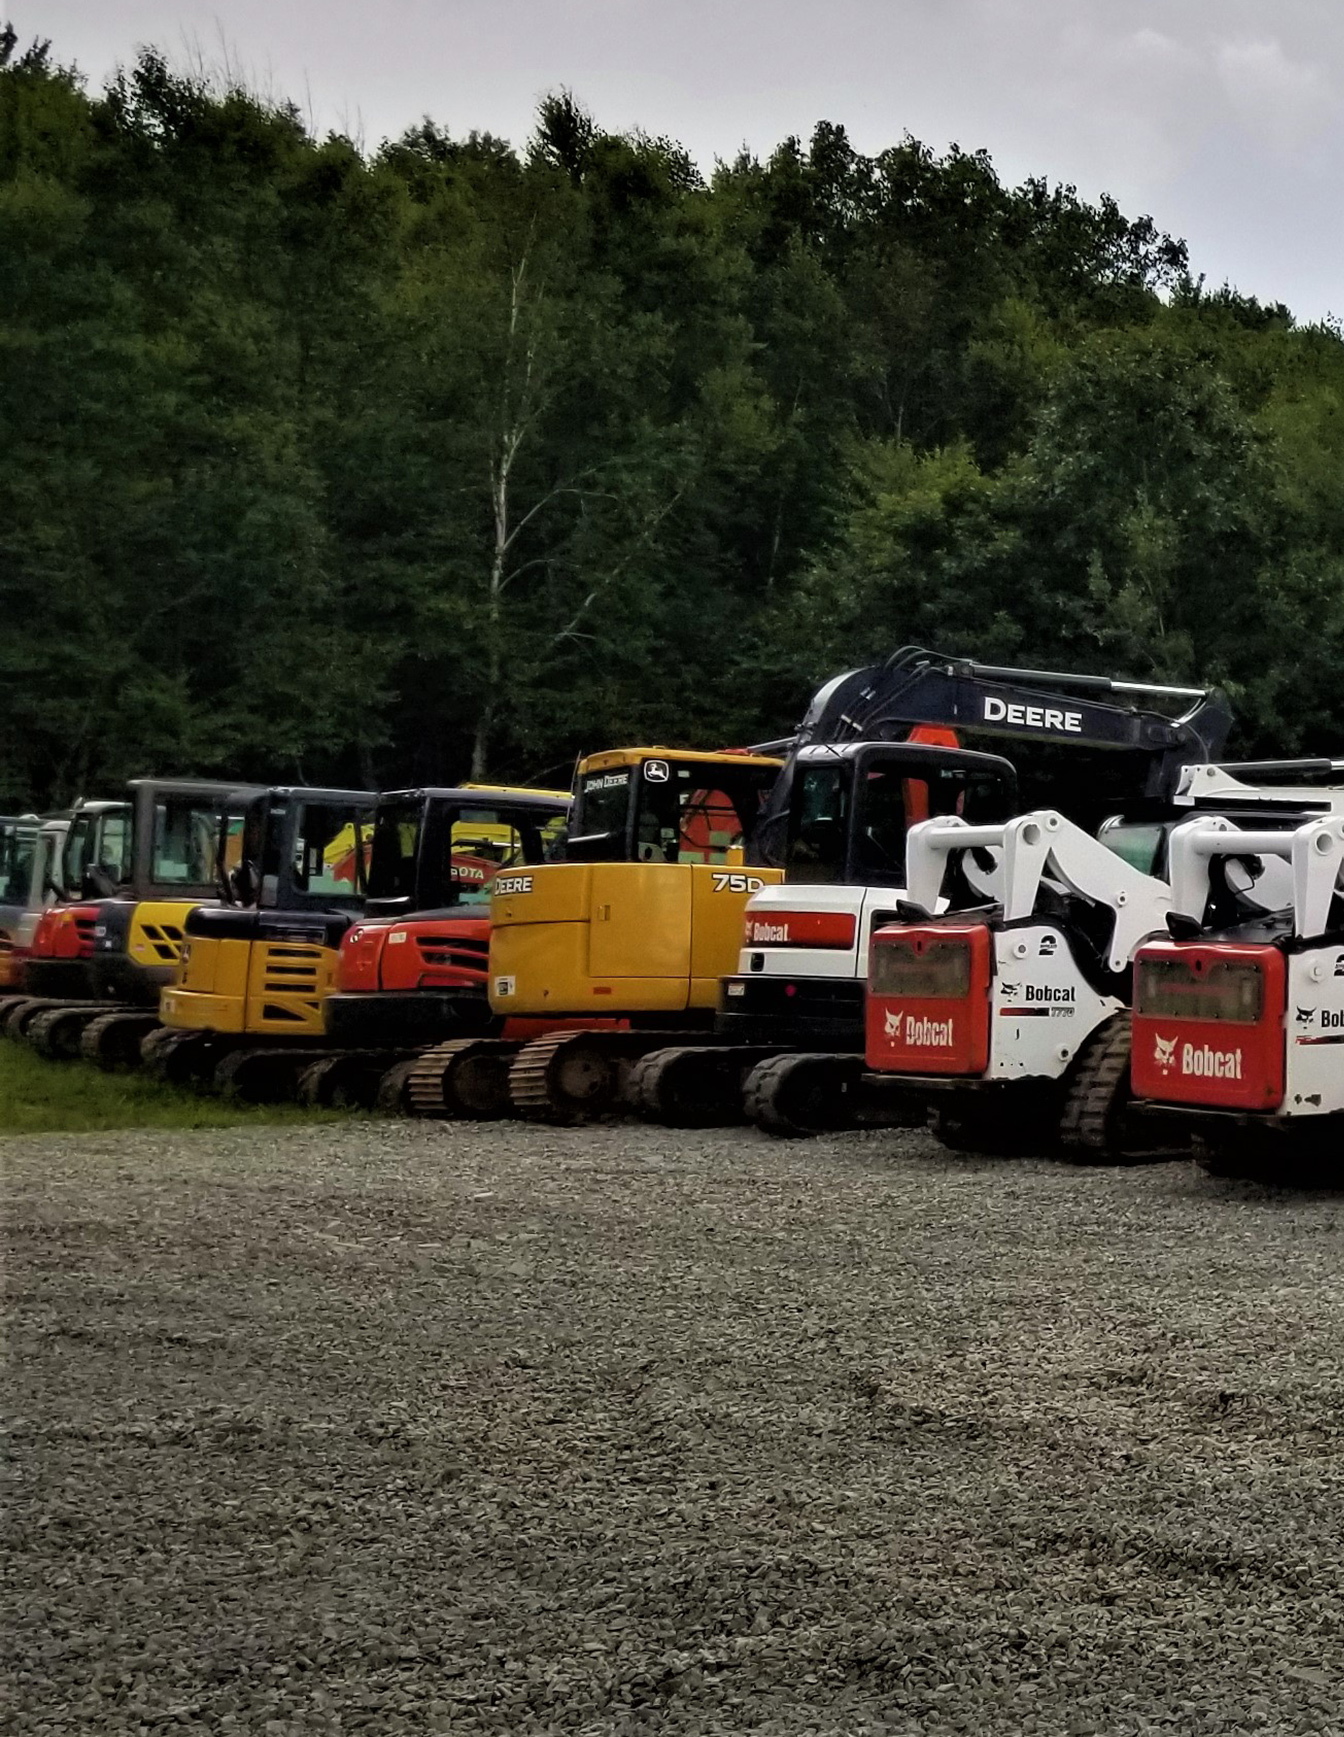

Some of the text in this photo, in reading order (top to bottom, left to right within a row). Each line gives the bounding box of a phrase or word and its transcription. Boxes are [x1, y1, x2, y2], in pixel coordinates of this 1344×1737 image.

[983, 696, 1082, 732] DEERE
[494, 876, 532, 896] DEERE
[712, 873, 764, 893] 75D
[753, 922, 788, 942] Bobcat
[1025, 985, 1076, 1002] Bobcat
[905, 1016, 953, 1047] Bobcat
[1182, 1042, 1242, 1080] Bobcat
